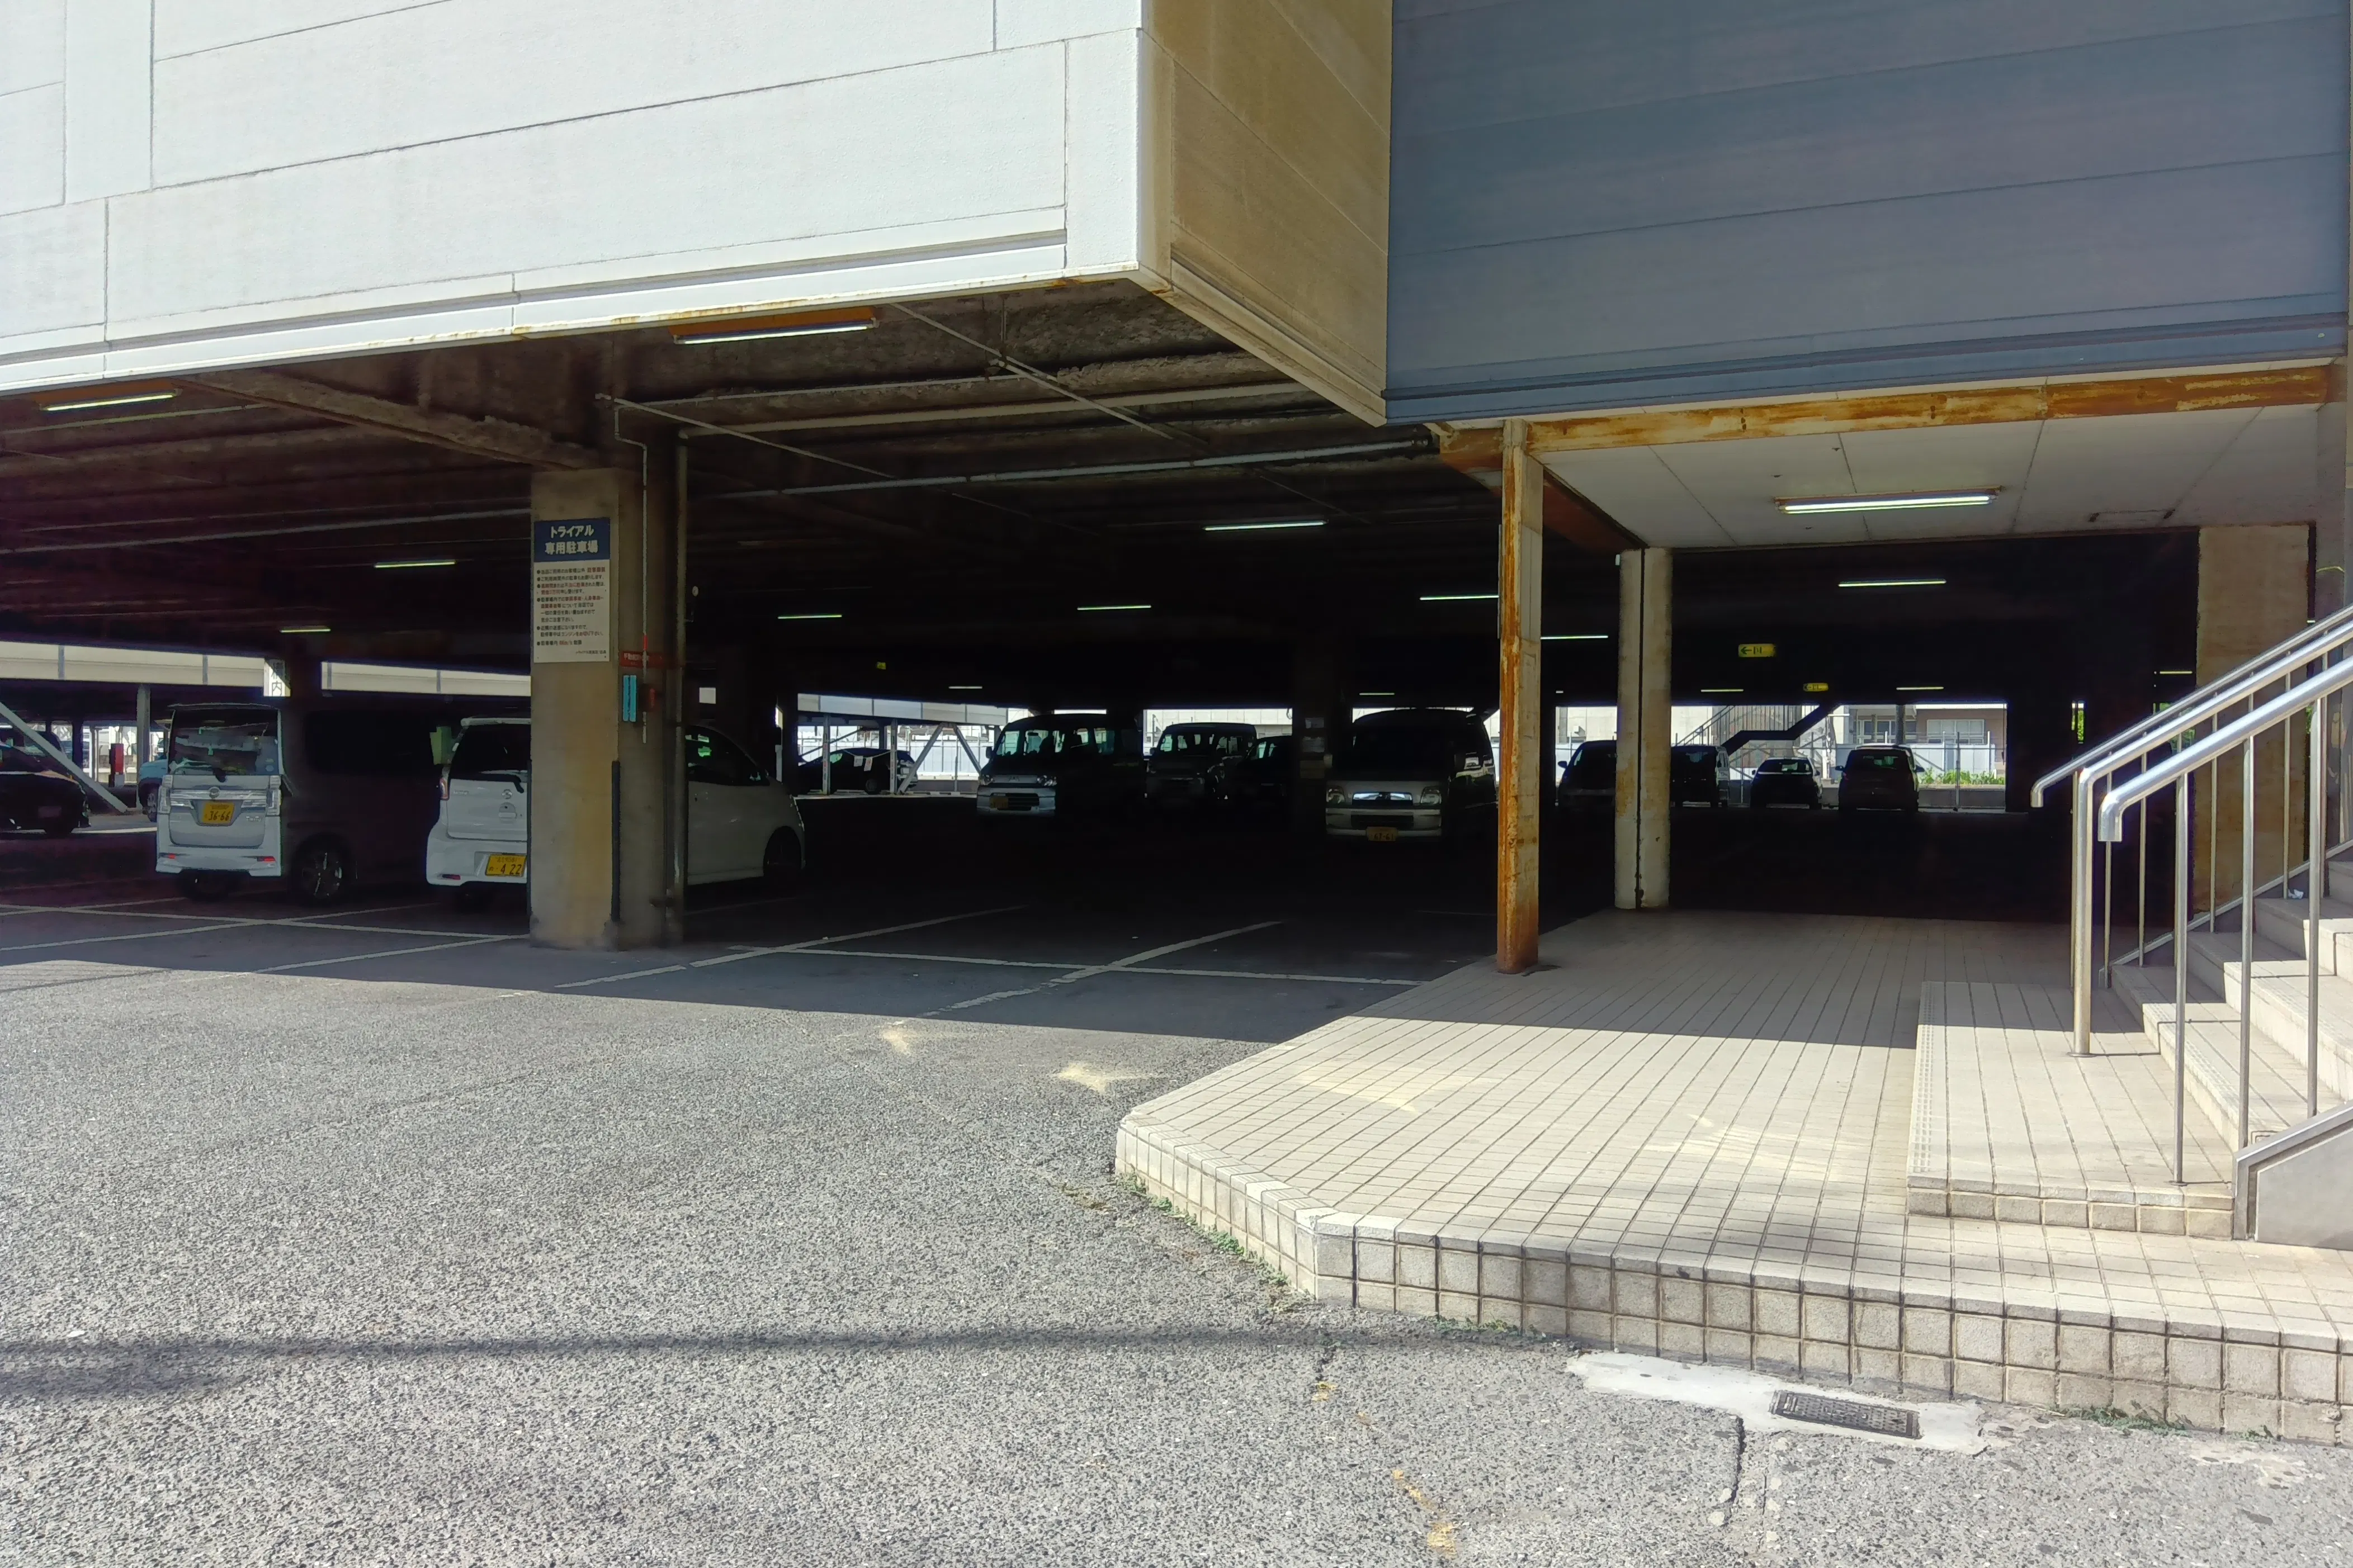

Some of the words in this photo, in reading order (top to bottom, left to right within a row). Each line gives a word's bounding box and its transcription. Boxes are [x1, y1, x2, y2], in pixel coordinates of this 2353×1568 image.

[551, 524, 594, 538] トライアル
[545, 539, 598, 555] 専用駐車場
